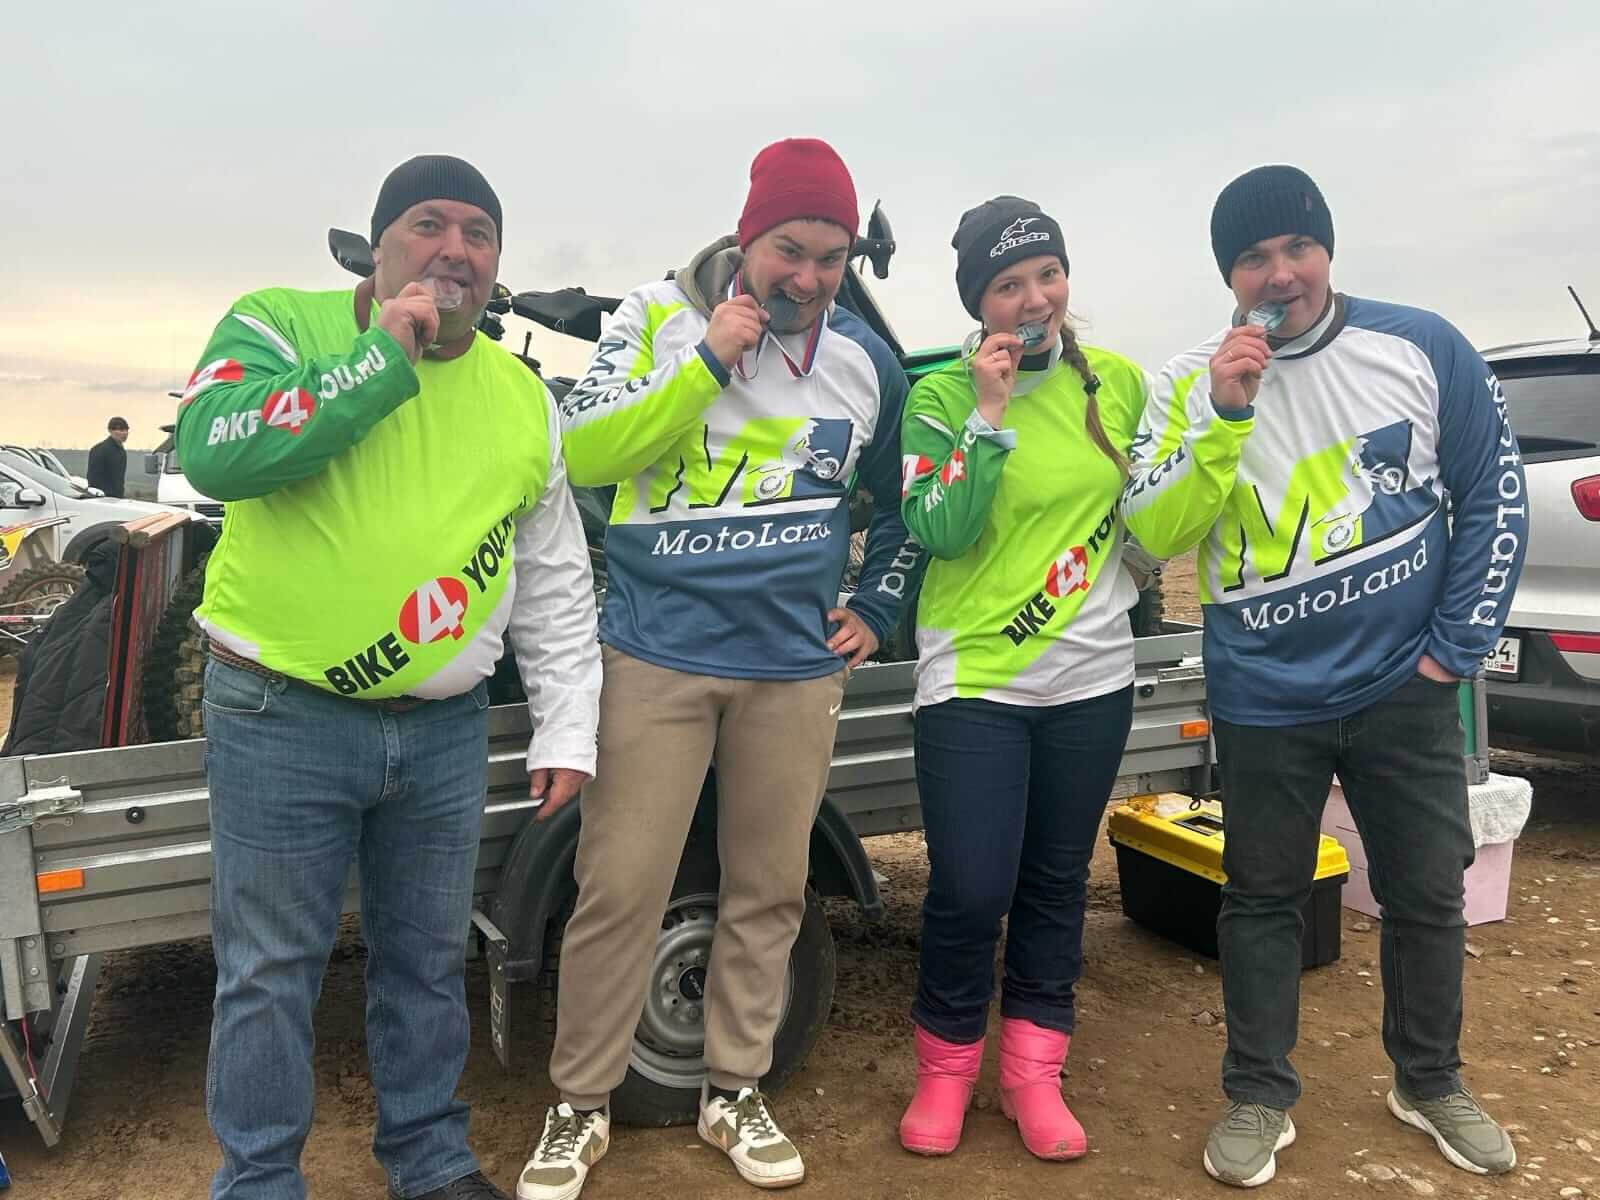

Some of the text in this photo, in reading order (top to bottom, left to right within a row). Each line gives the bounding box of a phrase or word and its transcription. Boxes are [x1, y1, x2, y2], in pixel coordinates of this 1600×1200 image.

[267, 386, 309, 428] 4
[1000, 591, 1057, 647] BIKE
[1241, 539, 1429, 630] MotoLand
[324, 632, 411, 695] BIKE
[416, 579, 464, 644] 4
